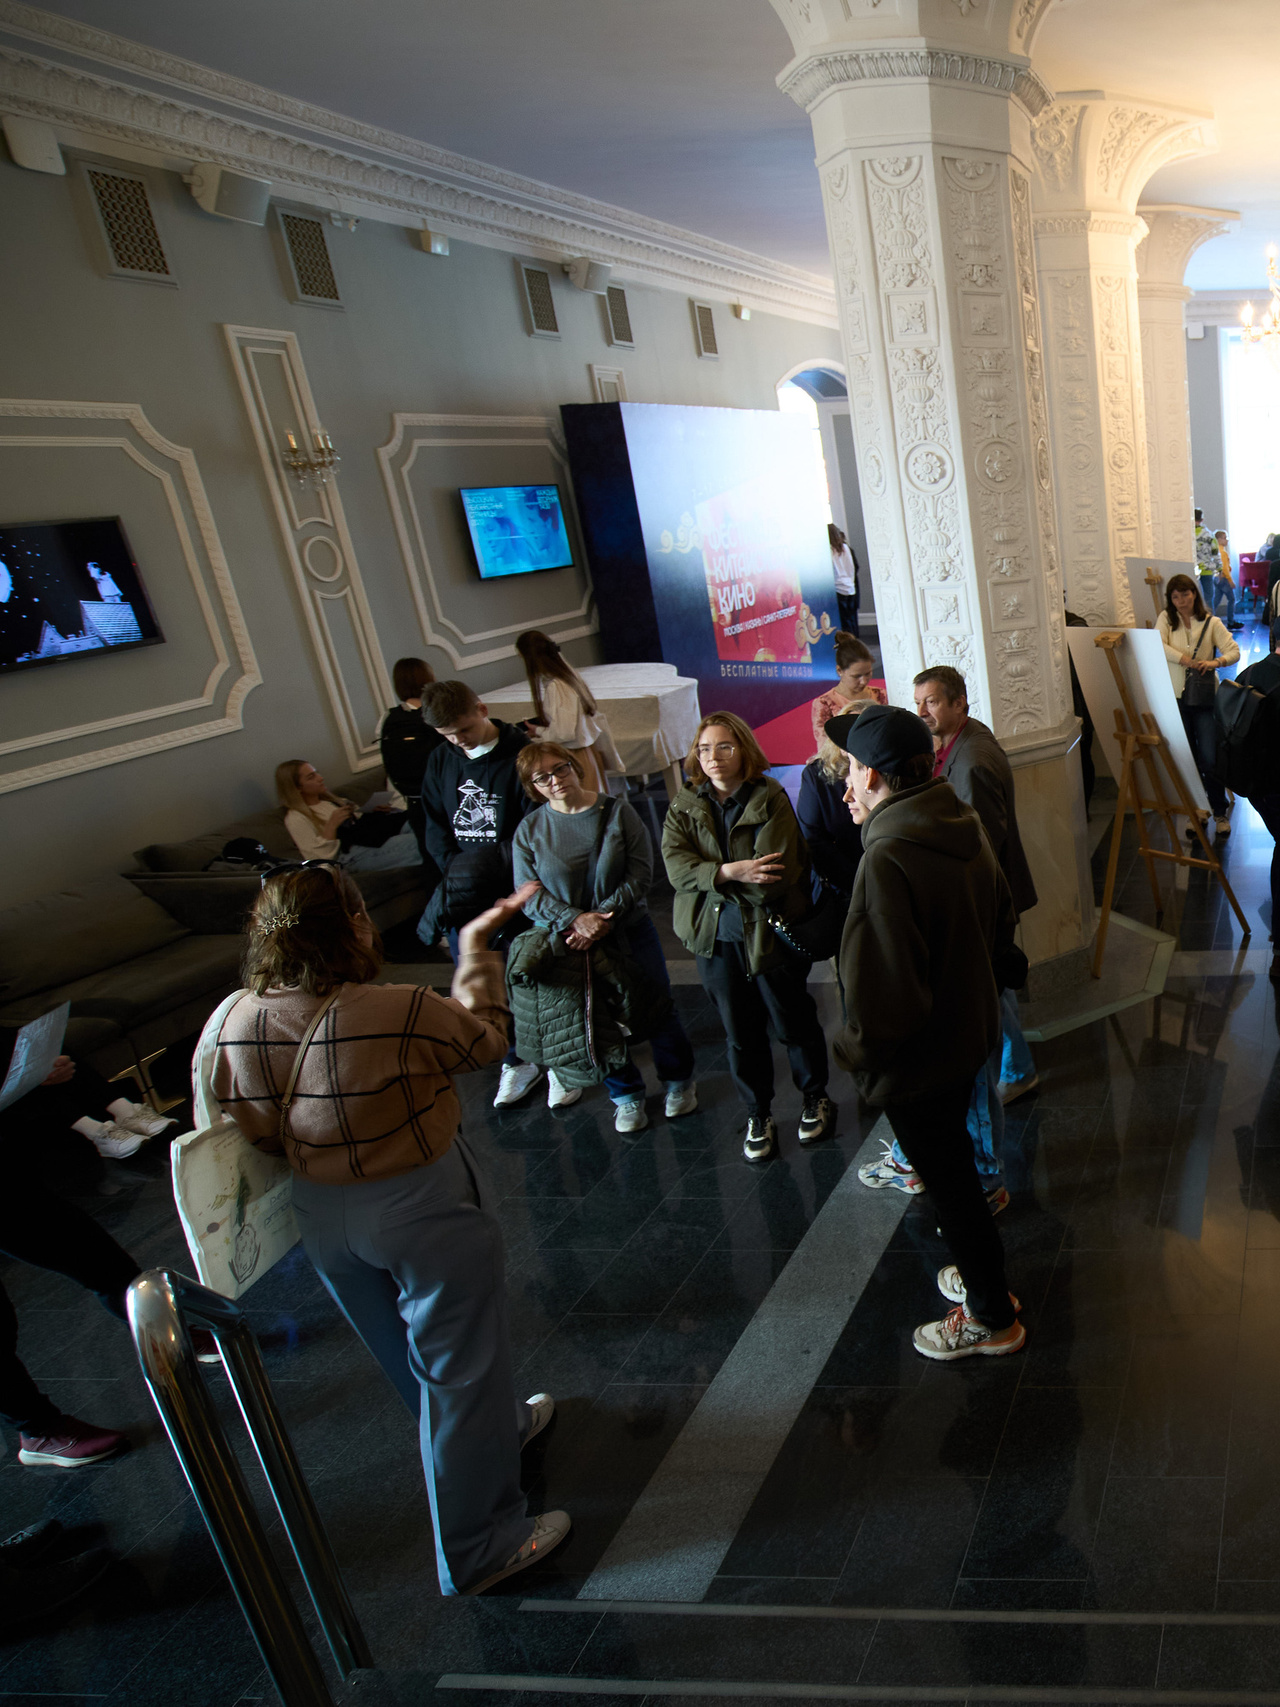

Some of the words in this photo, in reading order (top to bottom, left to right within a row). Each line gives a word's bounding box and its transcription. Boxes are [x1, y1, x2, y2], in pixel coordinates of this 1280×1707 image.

[717, 581, 756, 614] КИНО
[720, 664, 779, 677] БЕСПЛАТНЫЕ
[781, 666, 813, 677] ПОКАЗЫ
